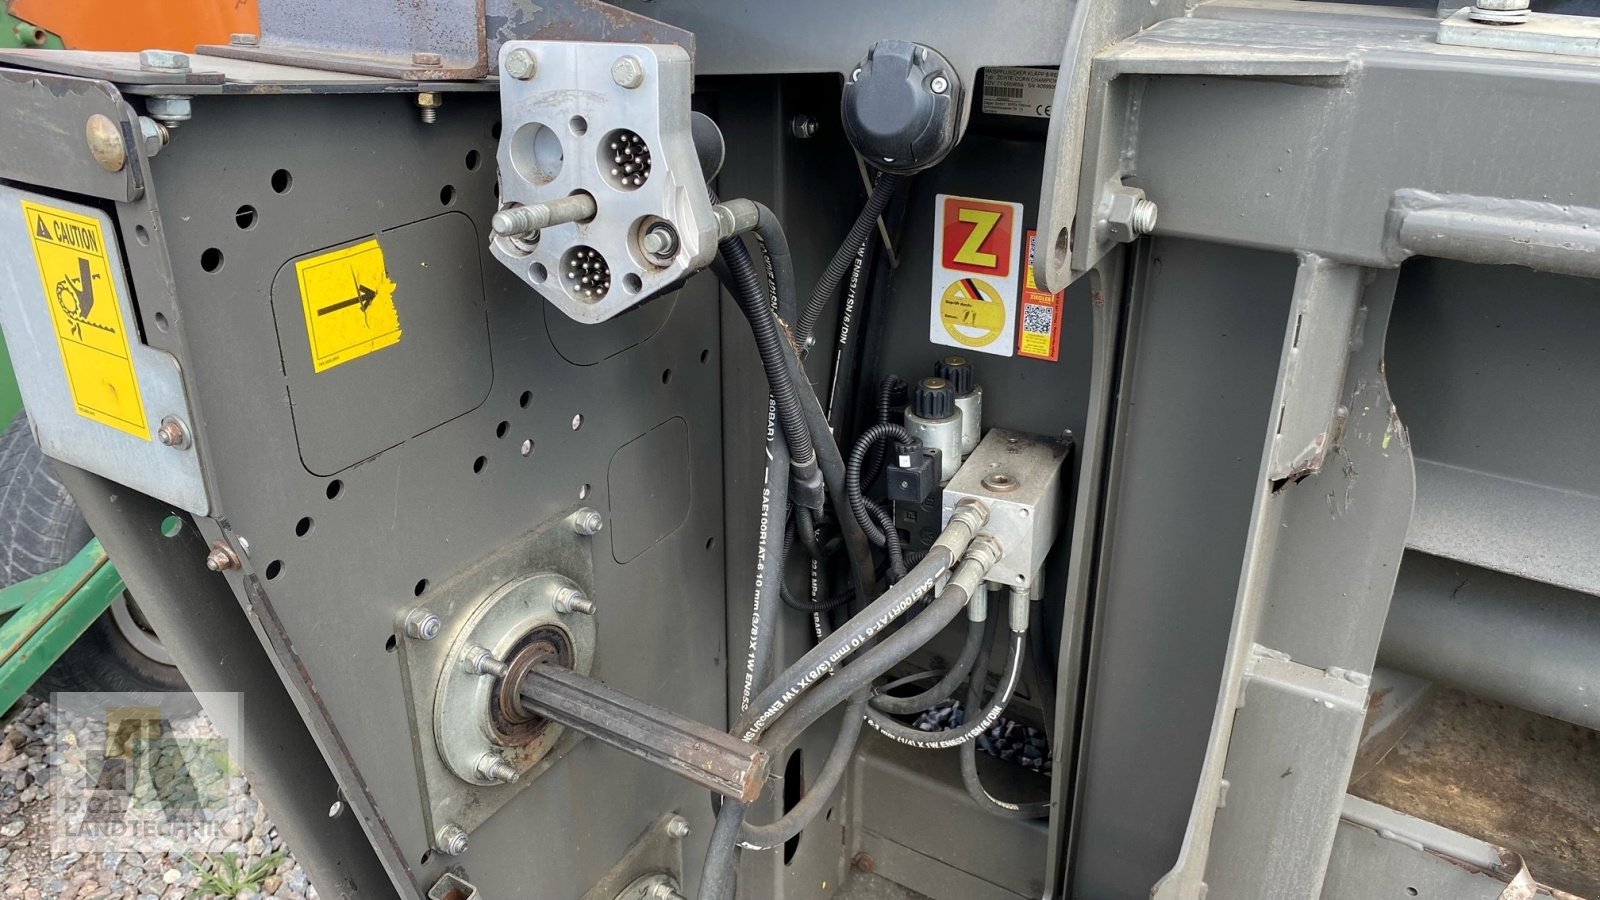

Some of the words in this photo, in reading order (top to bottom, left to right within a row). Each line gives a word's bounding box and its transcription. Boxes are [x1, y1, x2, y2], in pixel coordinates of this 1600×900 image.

[54, 220, 98, 252] CAUTION
[953, 208, 1002, 268] Z
[757, 488, 770, 570] SAE100R1AT-6
[756, 574, 763, 588] 10
[866, 578, 934, 636] SAE100R1AT-6
[852, 633, 865, 647] 10
